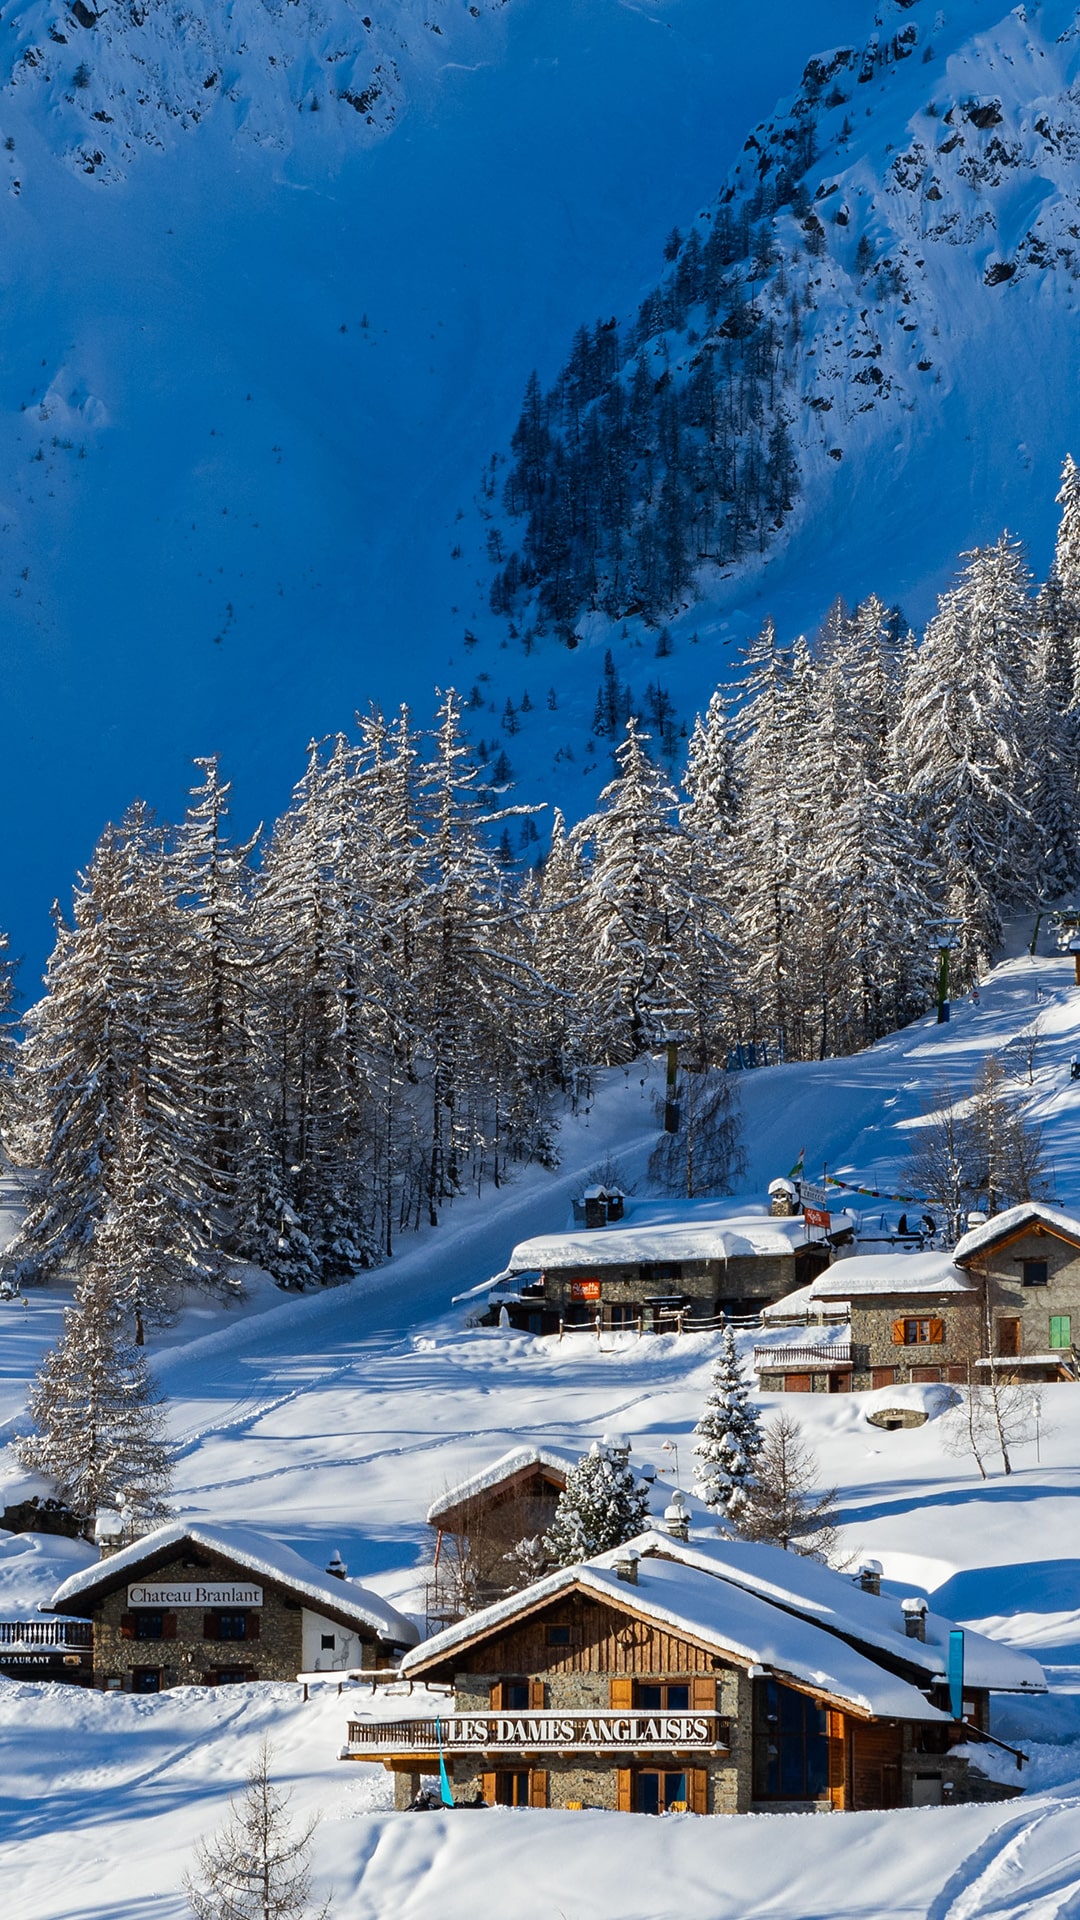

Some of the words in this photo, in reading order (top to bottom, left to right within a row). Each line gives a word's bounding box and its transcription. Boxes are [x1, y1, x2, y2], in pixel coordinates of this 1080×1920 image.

[129, 1587, 191, 1602] Chateau
[195, 1587, 260, 1602] Branlant
[448, 1720, 488, 1741] LES
[497, 1720, 575, 1741] DAMES
[582, 1719, 708, 1740] ANGLAISES
